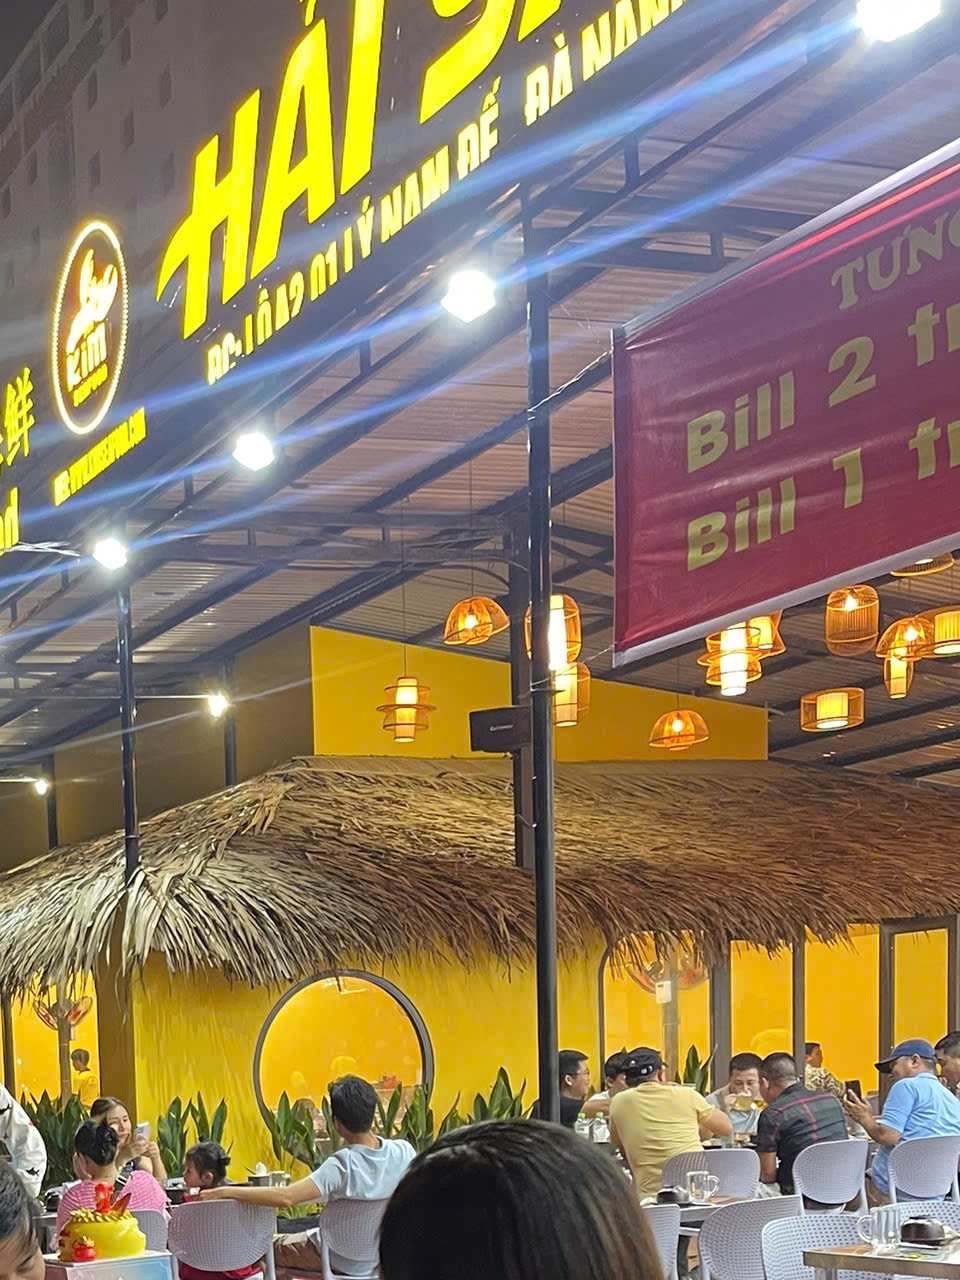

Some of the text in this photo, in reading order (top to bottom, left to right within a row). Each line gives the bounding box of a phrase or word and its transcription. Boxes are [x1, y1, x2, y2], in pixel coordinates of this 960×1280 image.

[381, 145, 450, 244] NAM
[687, 371, 796, 473] Bill
[828, 333, 877, 408] 2
[687, 478, 797, 571] Bill
[832, 447, 865, 509] 1
